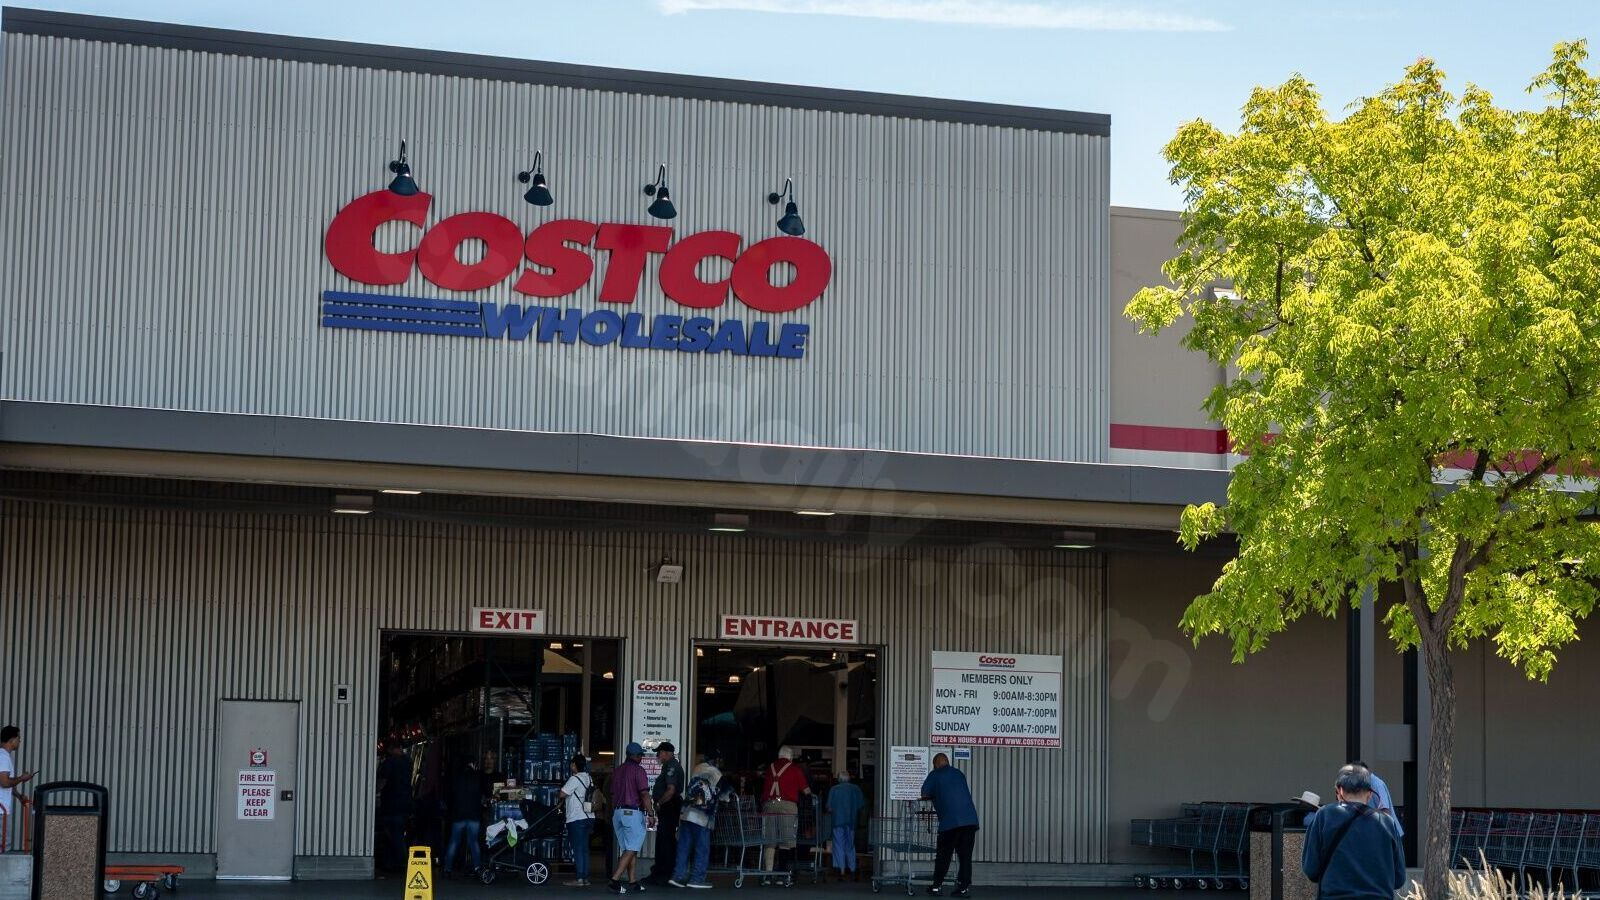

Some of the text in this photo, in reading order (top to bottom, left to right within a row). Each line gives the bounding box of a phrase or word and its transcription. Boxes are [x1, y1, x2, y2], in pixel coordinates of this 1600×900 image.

[325, 188, 832, 313] COSTCO
[481, 303, 809, 359] WHOLESALE
[479, 610, 537, 630] EXIT
[724, 618, 854, 640] ENTRANCE
[978, 655, 1016, 665] COSTCO
[961, 673, 1033, 685] MEMBERS ONLY
[637, 682, 677, 692] COSTCO
[936, 689, 956, 698] MON
[963, 690, 978, 699] FRI
[993, 691, 1057, 702] 9:00AM-8:30PM
[935, 705, 981, 715] SATURDAY
[993, 707, 1057, 718] 9:00AM-7:00PM
[935, 722, 970, 732] SUNDAY
[992, 723, 1057, 734] 9:00AM-7:00PM
[932, 735, 948, 743] OPEN
[1005, 738, 1060, 746] WWW.COSTCO.COM
[240, 774, 274, 782] FIRE EXIT
[242, 789, 271, 797] PLEASE
[246, 798, 266, 806] KEEP
[243, 808, 268, 817] CLEAR
